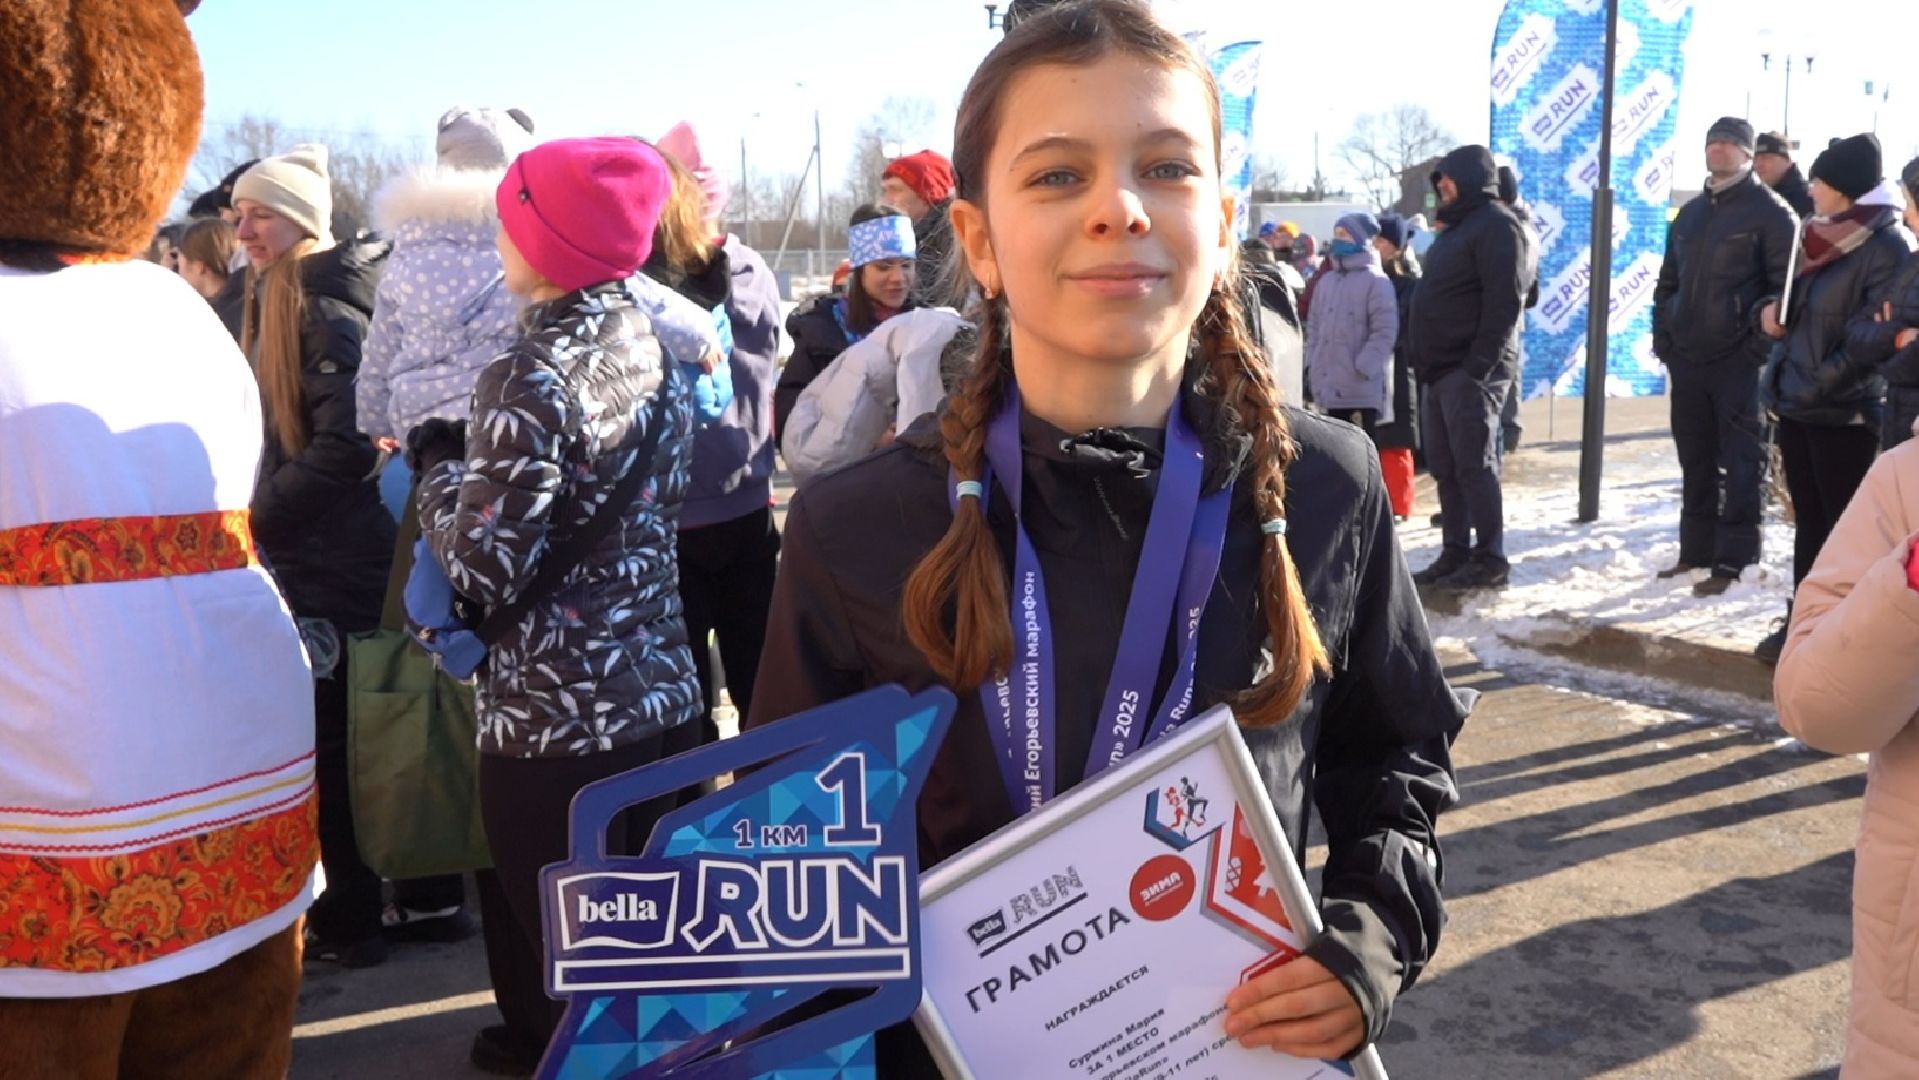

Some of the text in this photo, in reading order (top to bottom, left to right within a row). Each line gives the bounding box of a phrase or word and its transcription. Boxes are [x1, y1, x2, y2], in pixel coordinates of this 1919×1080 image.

[1507, 31, 1540, 70] RUN
[1550, 79, 1586, 119] RUN
[1628, 86, 1659, 122] RUN
[1618, 265, 1650, 299] RUN
[1022, 571, 1042, 657] марафон
[1022, 662, 1043, 780] Егорьевский
[1113, 690, 1139, 738] 2025
[815, 752, 882, 846] 1
[733, 819, 754, 848] 1
[577, 856, 909, 952] bella RUN
[1009, 865, 1084, 924] RUN
[1140, 872, 1181, 902] ЗИМА
[965, 906, 1131, 1013] ГРАМОТА
[1045, 965, 1149, 1031] НАГРАЖДАЕТСЯ
[1124, 1008, 1165, 1035] Мария
[1105, 1054, 1113, 1063] 1
[1116, 1027, 1160, 1056] МЕСТО
